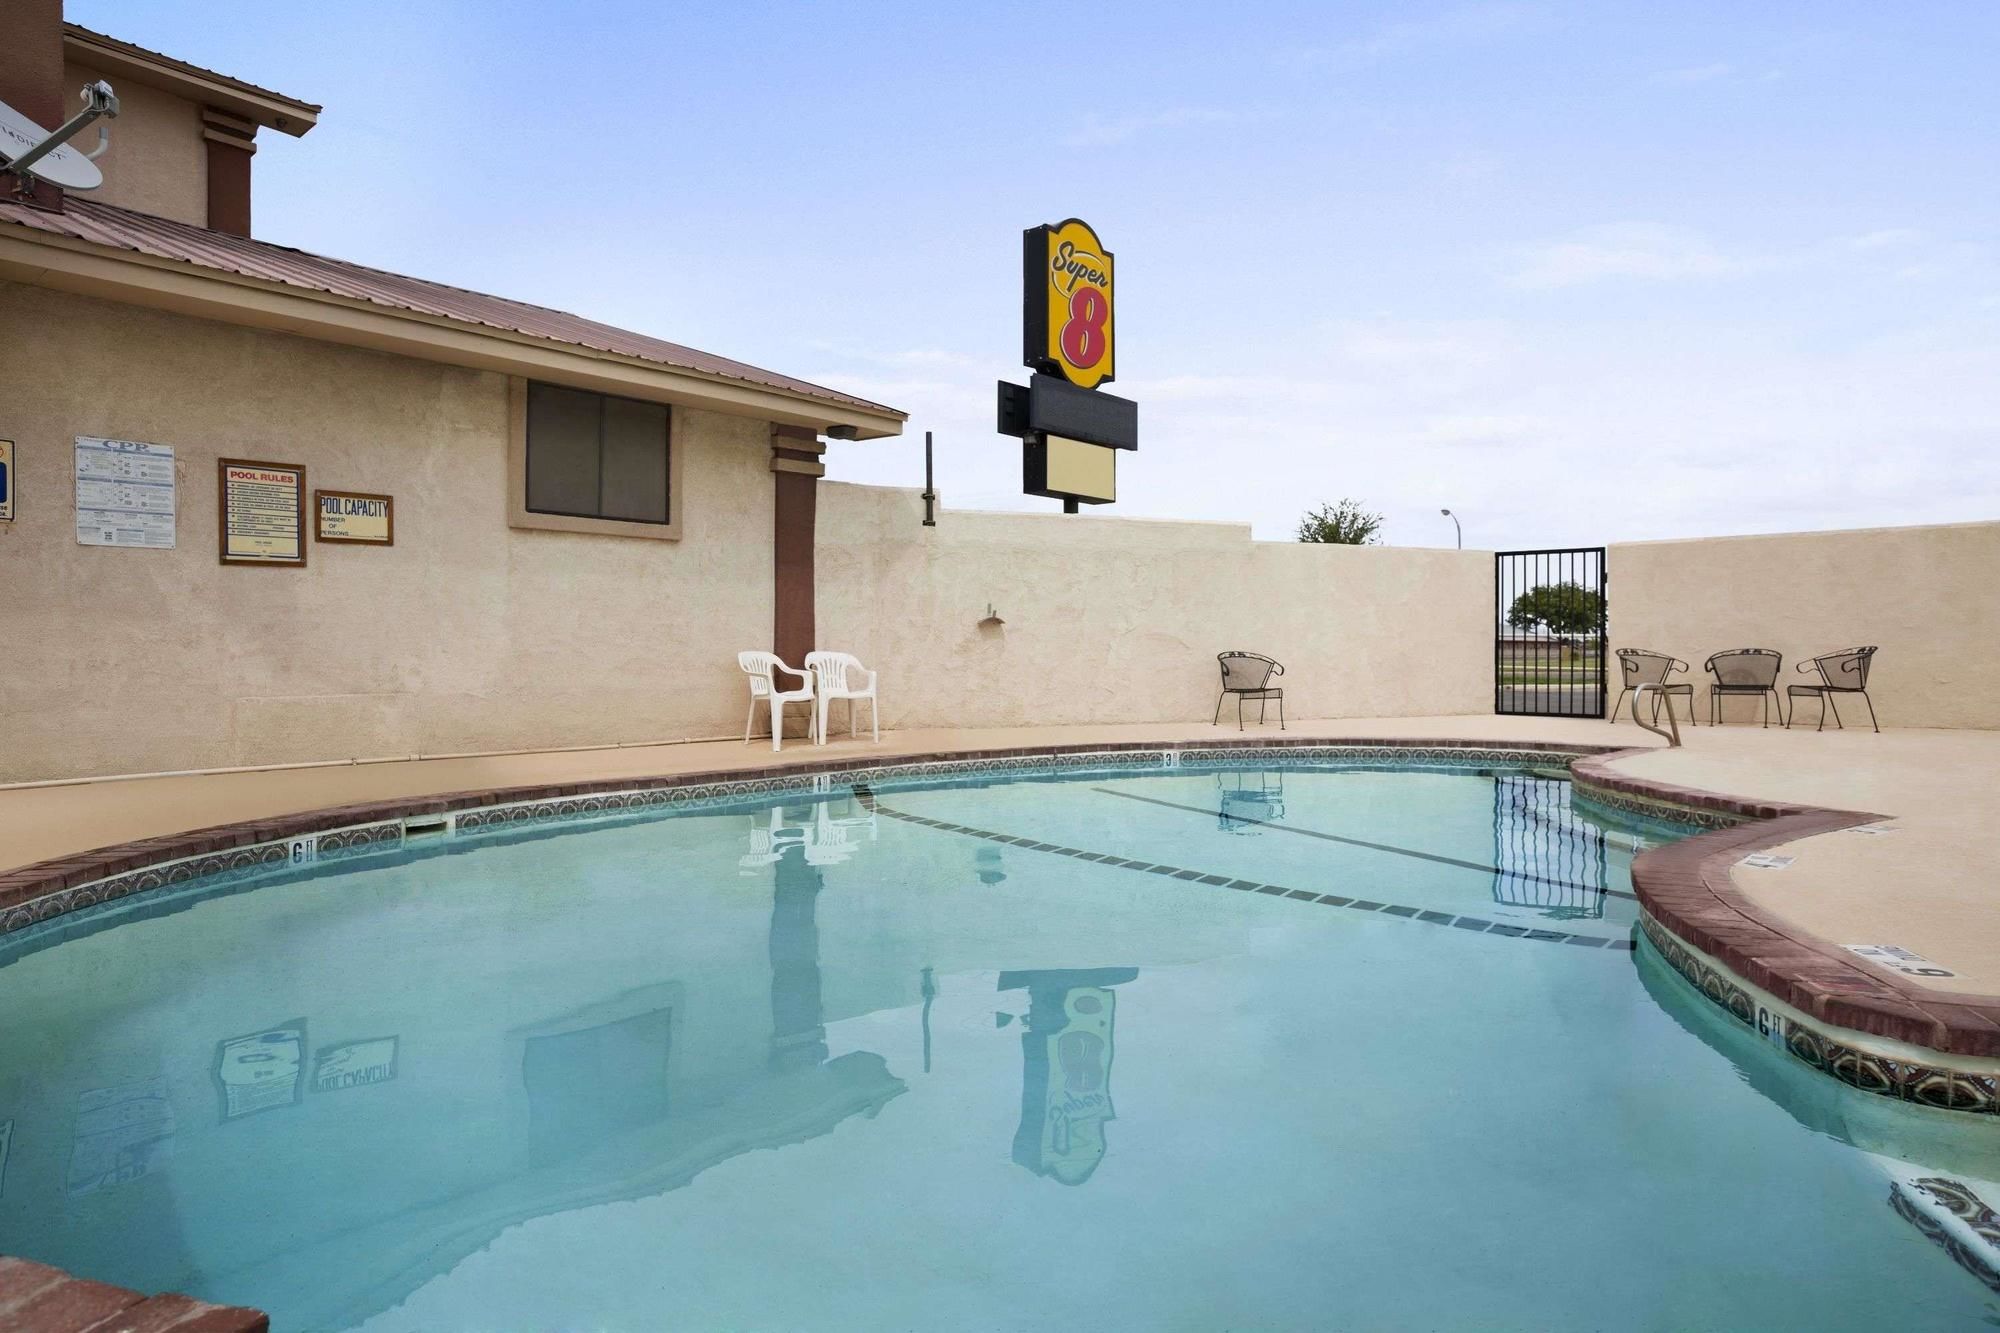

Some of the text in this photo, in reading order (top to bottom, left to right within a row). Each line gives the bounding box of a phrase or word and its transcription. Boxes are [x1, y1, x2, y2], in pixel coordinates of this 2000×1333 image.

[1052, 241, 1108, 292] Super
[1059, 286, 1108, 370] 8
[230, 471, 294, 484] POOL RULES
[320, 497, 388, 517] POOL CAPACITY
[1759, 1007, 1769, 1036] 6
